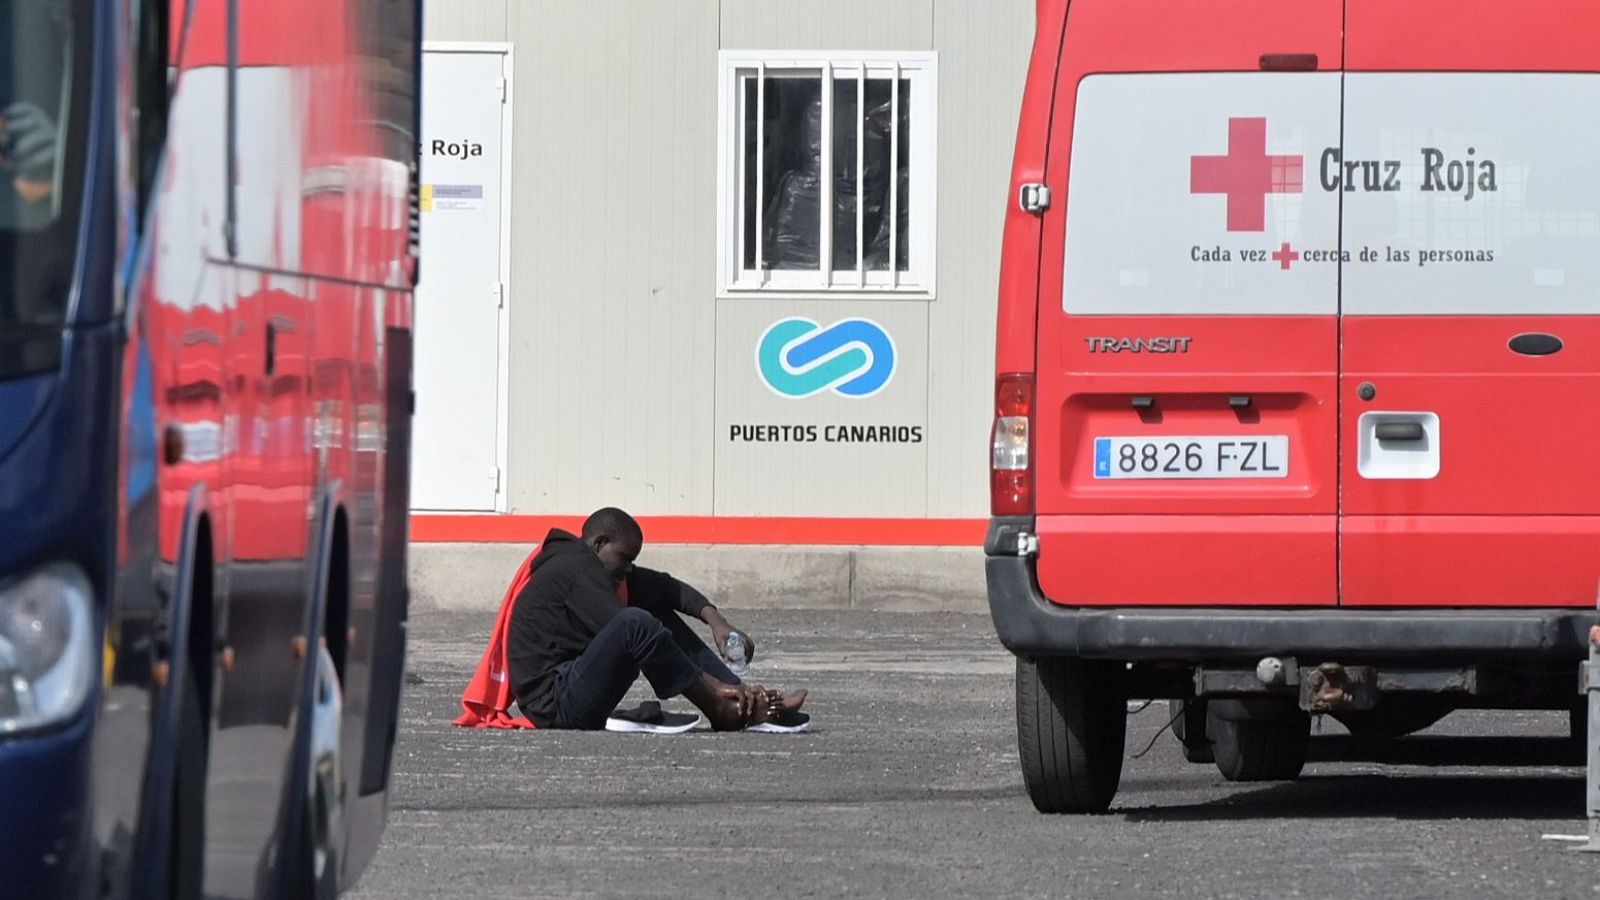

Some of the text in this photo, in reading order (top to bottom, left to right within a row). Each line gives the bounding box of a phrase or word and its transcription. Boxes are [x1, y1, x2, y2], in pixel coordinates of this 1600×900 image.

[432, 139, 483, 160] Roja
[1320, 147, 1498, 202] Cruz Roja
[1191, 246, 1494, 267] Cada vez cerca de las personas
[1086, 336, 1192, 353] TRANSIT
[730, 425, 922, 443] PUERTOS CANARIOS
[1118, 443, 1203, 473] 8826
